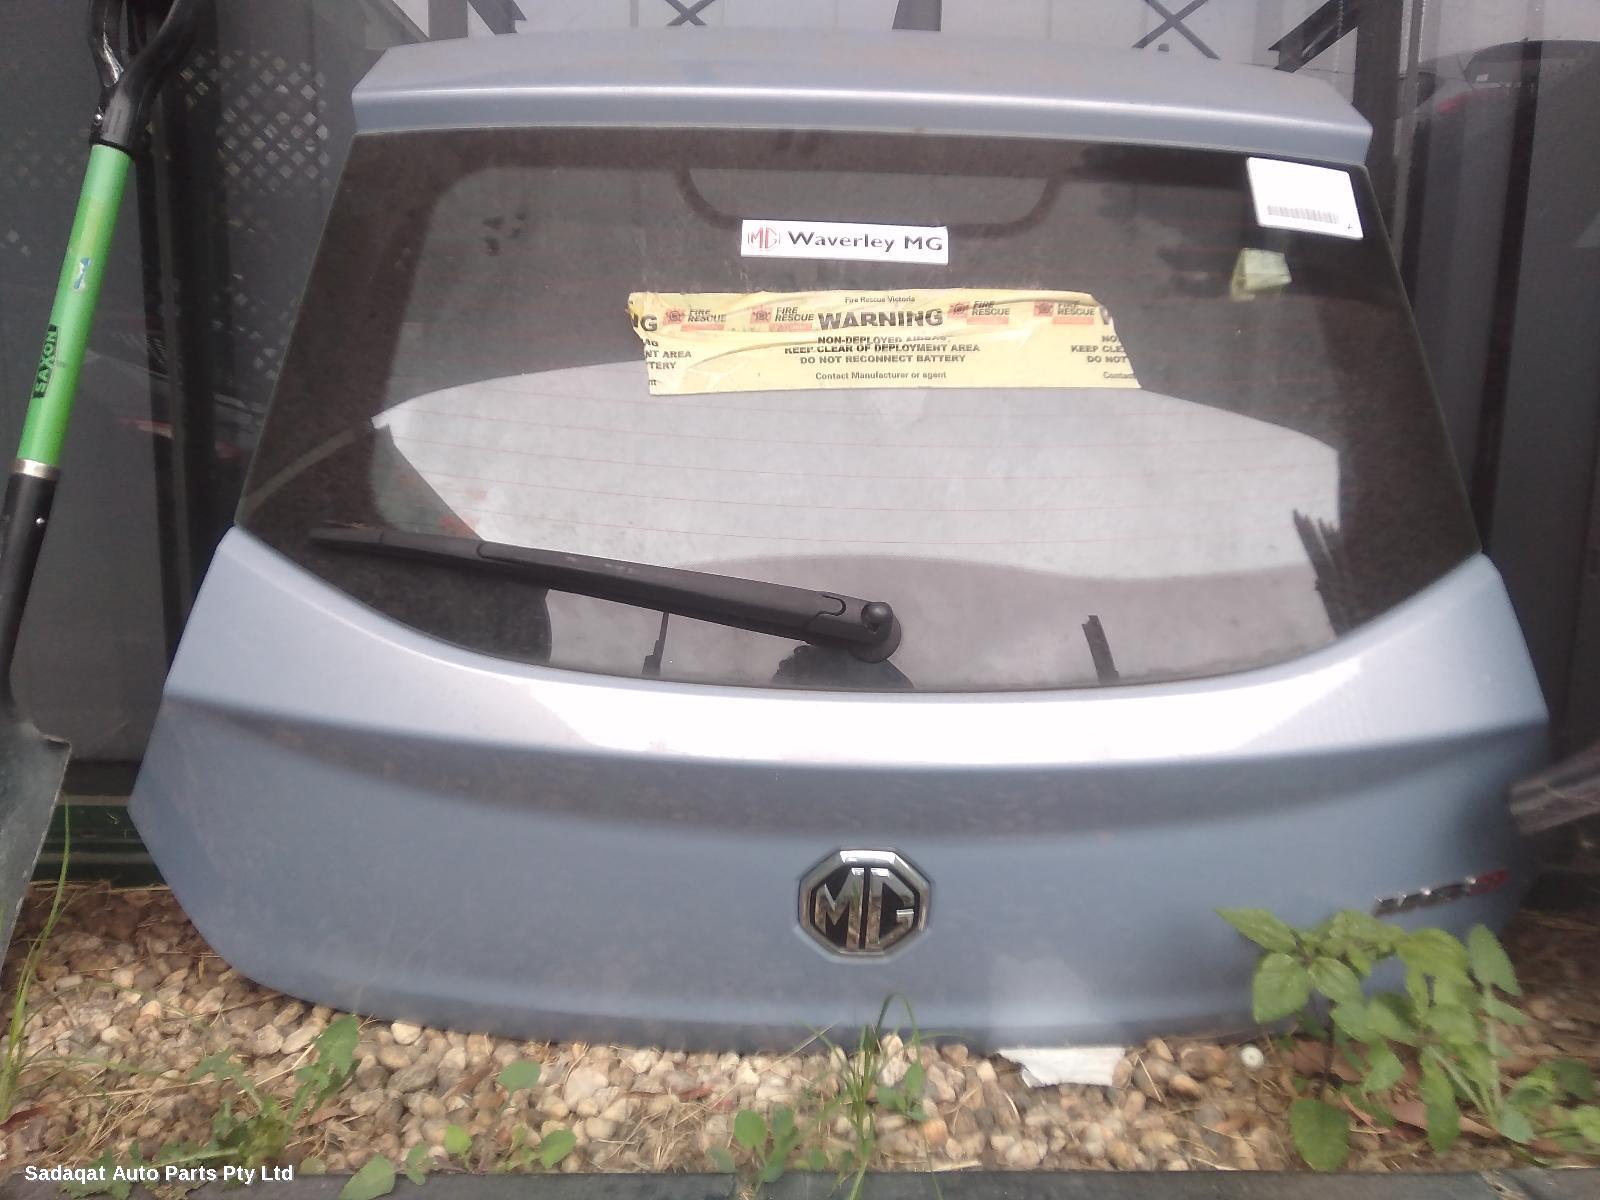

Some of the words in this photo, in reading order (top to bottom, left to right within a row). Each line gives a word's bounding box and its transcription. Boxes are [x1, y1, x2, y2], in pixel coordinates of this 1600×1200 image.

[788, 231, 896, 253] Waverley
[903, 236, 944, 252] MG
[844, 296, 859, 304] Fire
[887, 295, 916, 303] Victoria
[972, 300, 996, 309] FIRE
[776, 306, 799, 314] FIRE
[972, 308, 1010, 316] RESCUE
[1057, 308, 1096, 316] RESCUE
[687, 314, 728, 323] RESCUE
[774, 313, 815, 322] RESCUE
[817, 308, 944, 330] WARNING
[1101, 335, 1119, 343] NO
[784, 346, 814, 354] KEEP
[816, 345, 854, 353] CLEAR
[856, 344, 871, 352] OF
[874, 344, 948, 352] DEPLOYMENT
[950, 344, 981, 352] AREA
[1070, 344, 1099, 353] KEEP
[662, 350, 692, 358] AREA
[34, 329, 58, 394] SAXON
[800, 356, 816, 364] DO
[819, 355, 843, 364] NOT
[845, 354, 914, 363] RECONNECT
[916, 354, 966, 363] BATTERY
[1087, 355, 1102, 363] DO
[1105, 355, 1127, 363] NOT
[645, 361, 677, 369] TERY
[815, 371, 850, 380] Contact
[851, 371, 909, 379] Manufacturer
[922, 372, 947, 380] agent
[814, 867, 915, 949] MG
